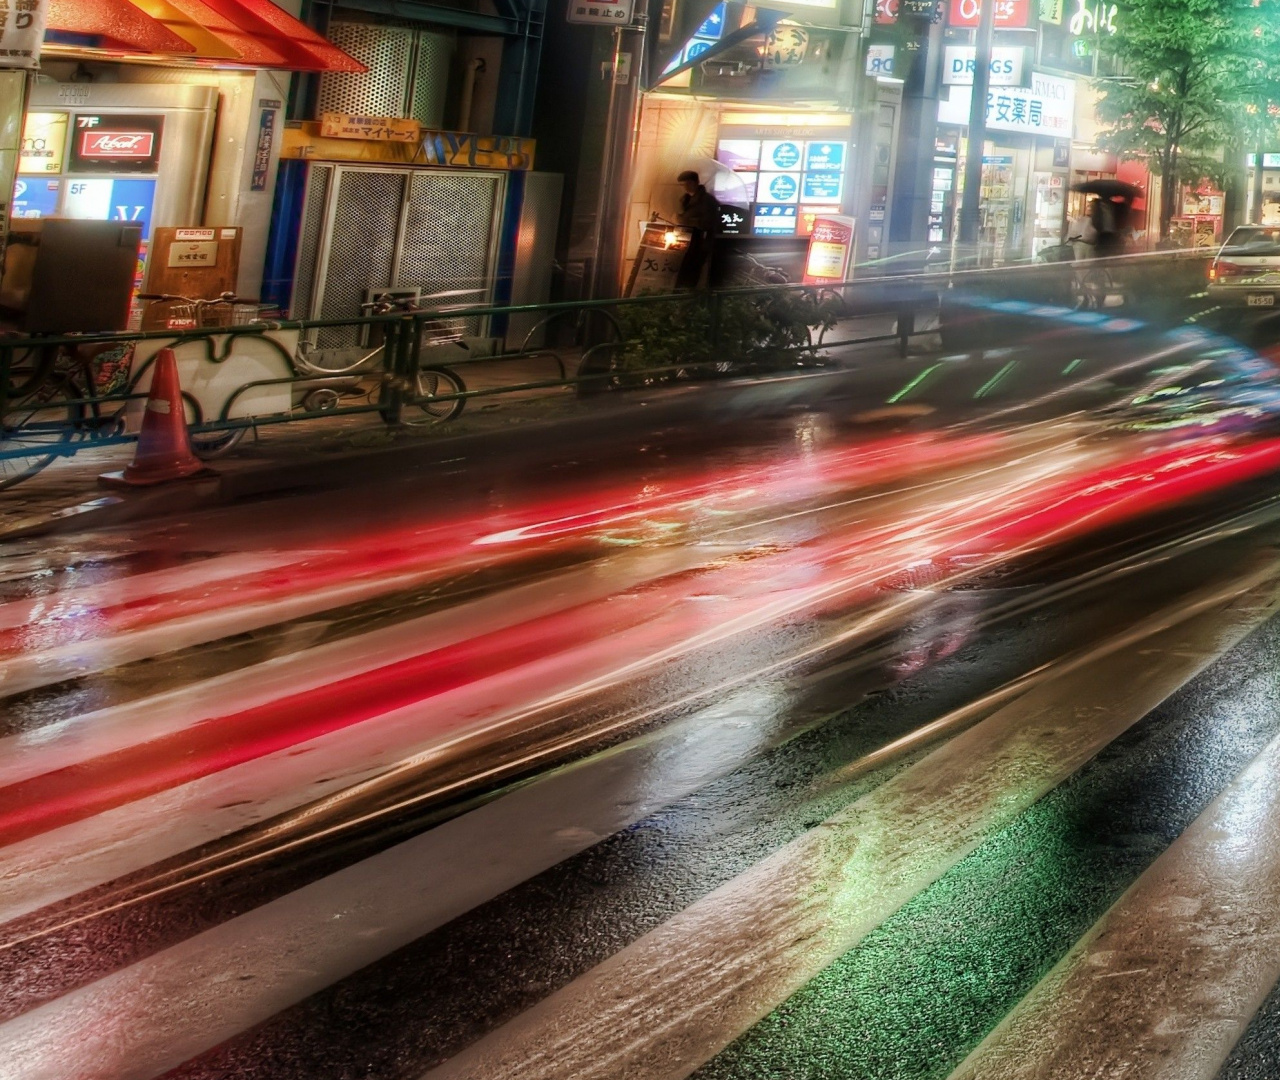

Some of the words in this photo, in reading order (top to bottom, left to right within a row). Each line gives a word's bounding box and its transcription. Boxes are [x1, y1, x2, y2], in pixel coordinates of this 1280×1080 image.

[952, 58, 1013, 74] DRGS
[77, 116, 100, 128] 7F
[70, 183, 88, 195] 5F
